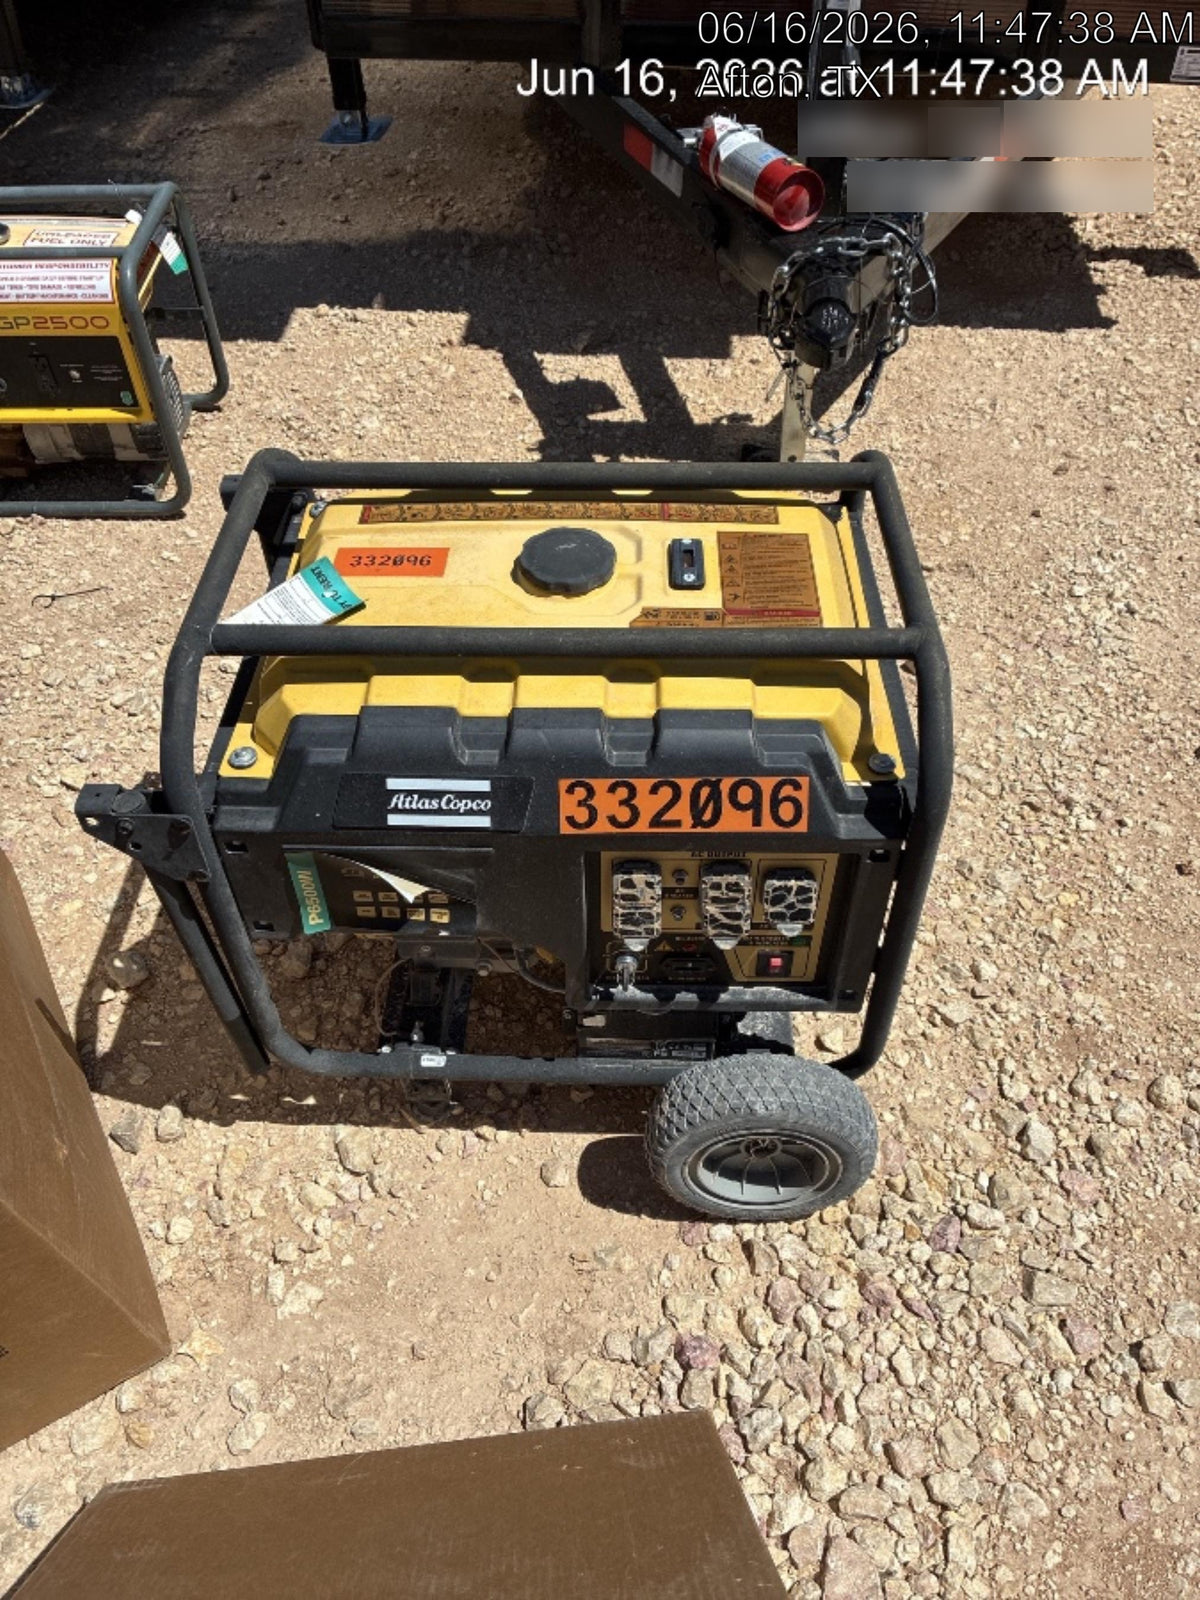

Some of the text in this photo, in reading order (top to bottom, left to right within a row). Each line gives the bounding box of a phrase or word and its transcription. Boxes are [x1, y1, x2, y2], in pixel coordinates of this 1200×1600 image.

[349, 554, 432, 567] 332096
[387, 794, 492, 814] Atlas Copco
[564, 777, 803, 830] 332096
